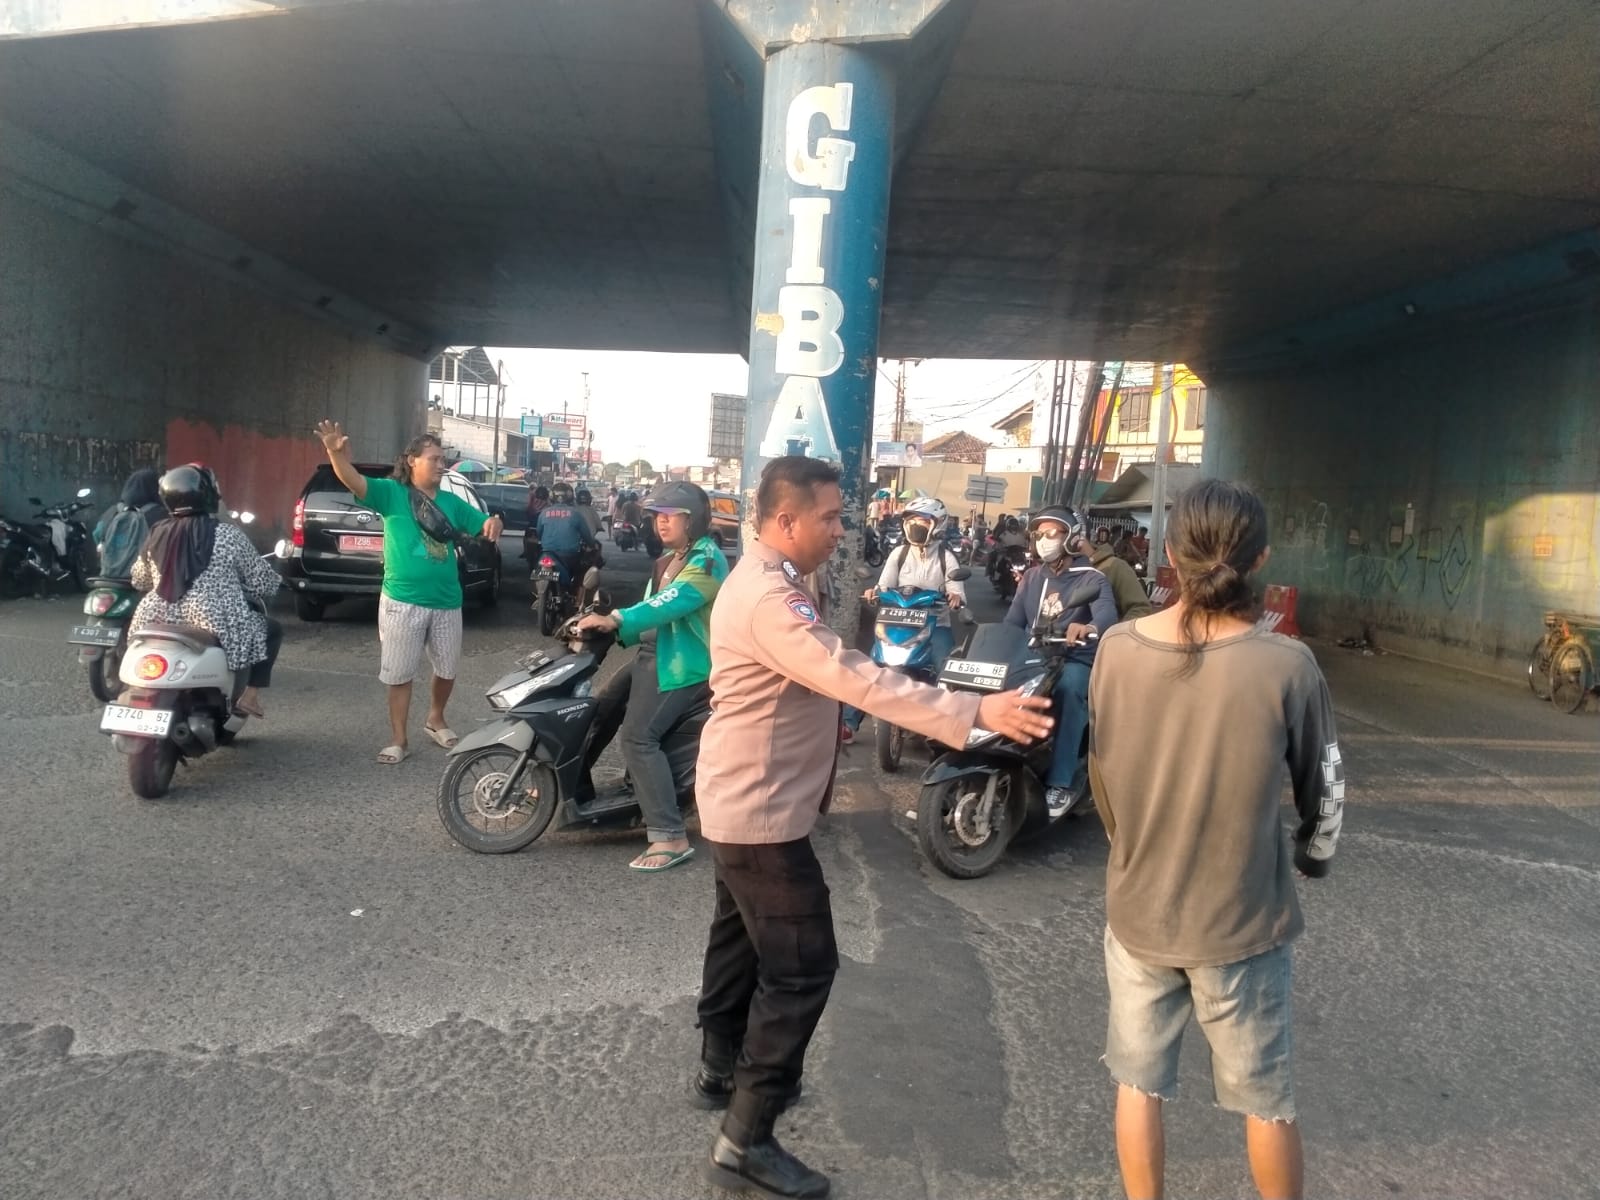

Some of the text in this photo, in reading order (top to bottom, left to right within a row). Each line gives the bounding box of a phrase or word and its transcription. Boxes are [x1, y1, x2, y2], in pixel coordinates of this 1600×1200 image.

[107, 707, 114, 717] T
[116, 709, 143, 720] 2740
[556, 702, 590, 716] HONDA
